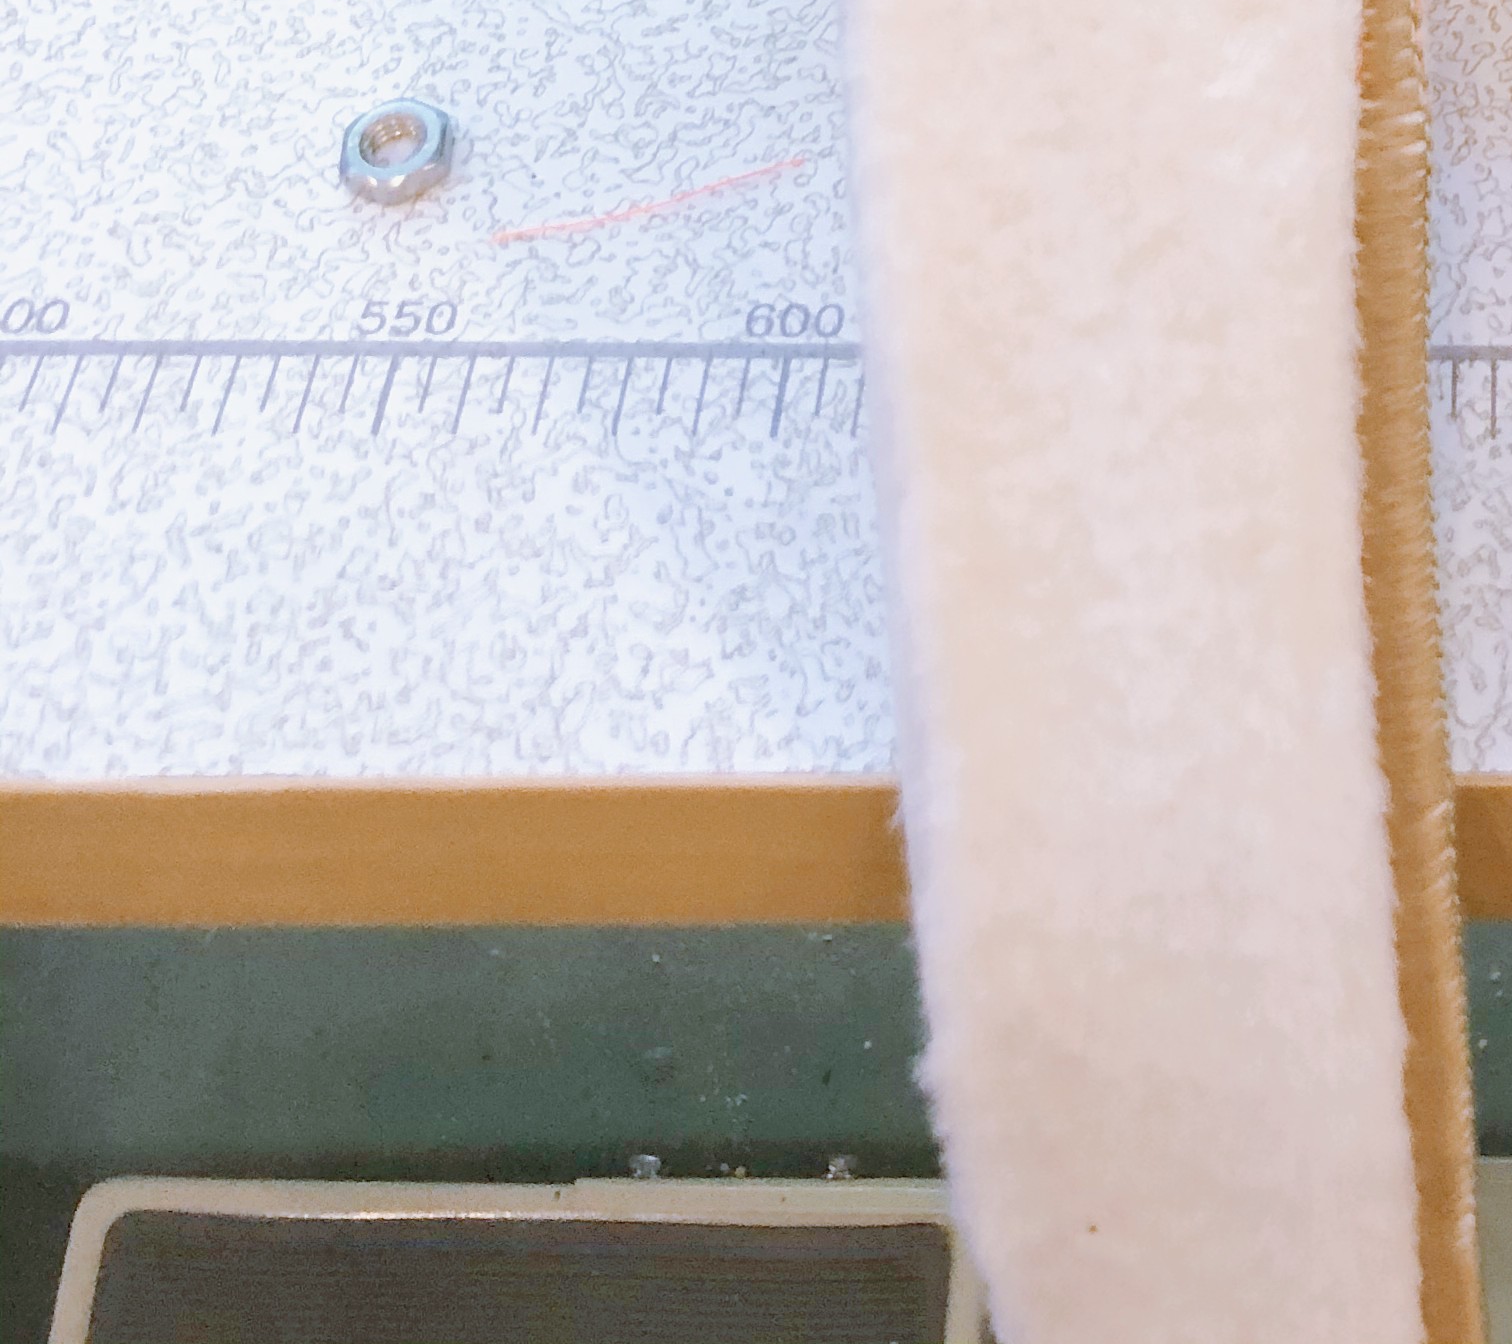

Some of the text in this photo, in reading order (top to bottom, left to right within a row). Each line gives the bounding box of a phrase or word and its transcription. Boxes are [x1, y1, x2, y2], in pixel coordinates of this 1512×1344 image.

[0, 297, 70, 334] 00
[357, 300, 458, 337] 550
[745, 303, 845, 338] 600
